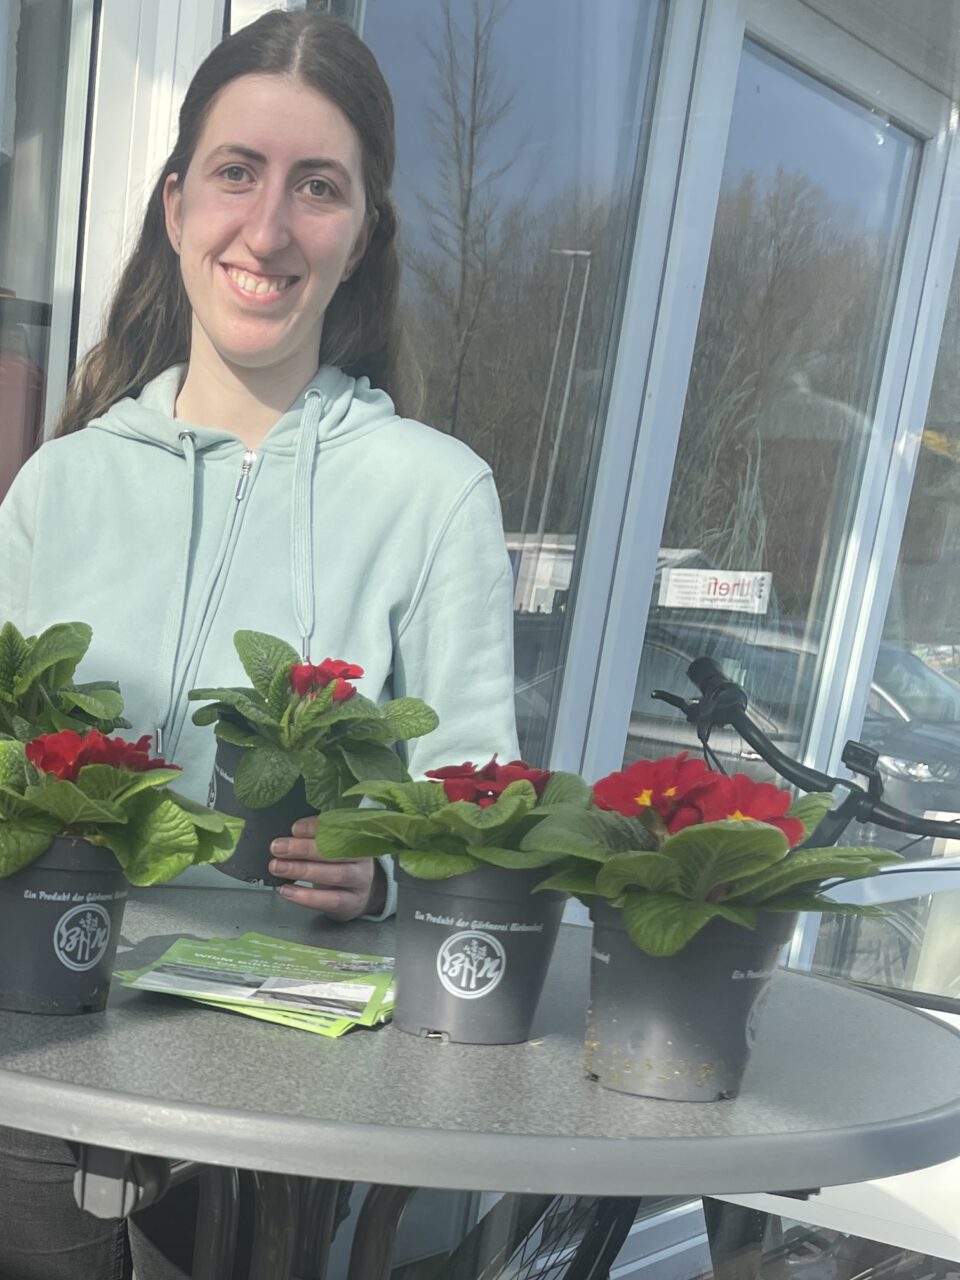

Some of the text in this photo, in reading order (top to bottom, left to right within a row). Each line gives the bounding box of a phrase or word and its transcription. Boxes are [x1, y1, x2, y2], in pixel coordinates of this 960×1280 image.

[23, 889, 37, 899] Ein
[38, 890, 71, 901] Produkt
[426, 912, 455, 926] Produkt
